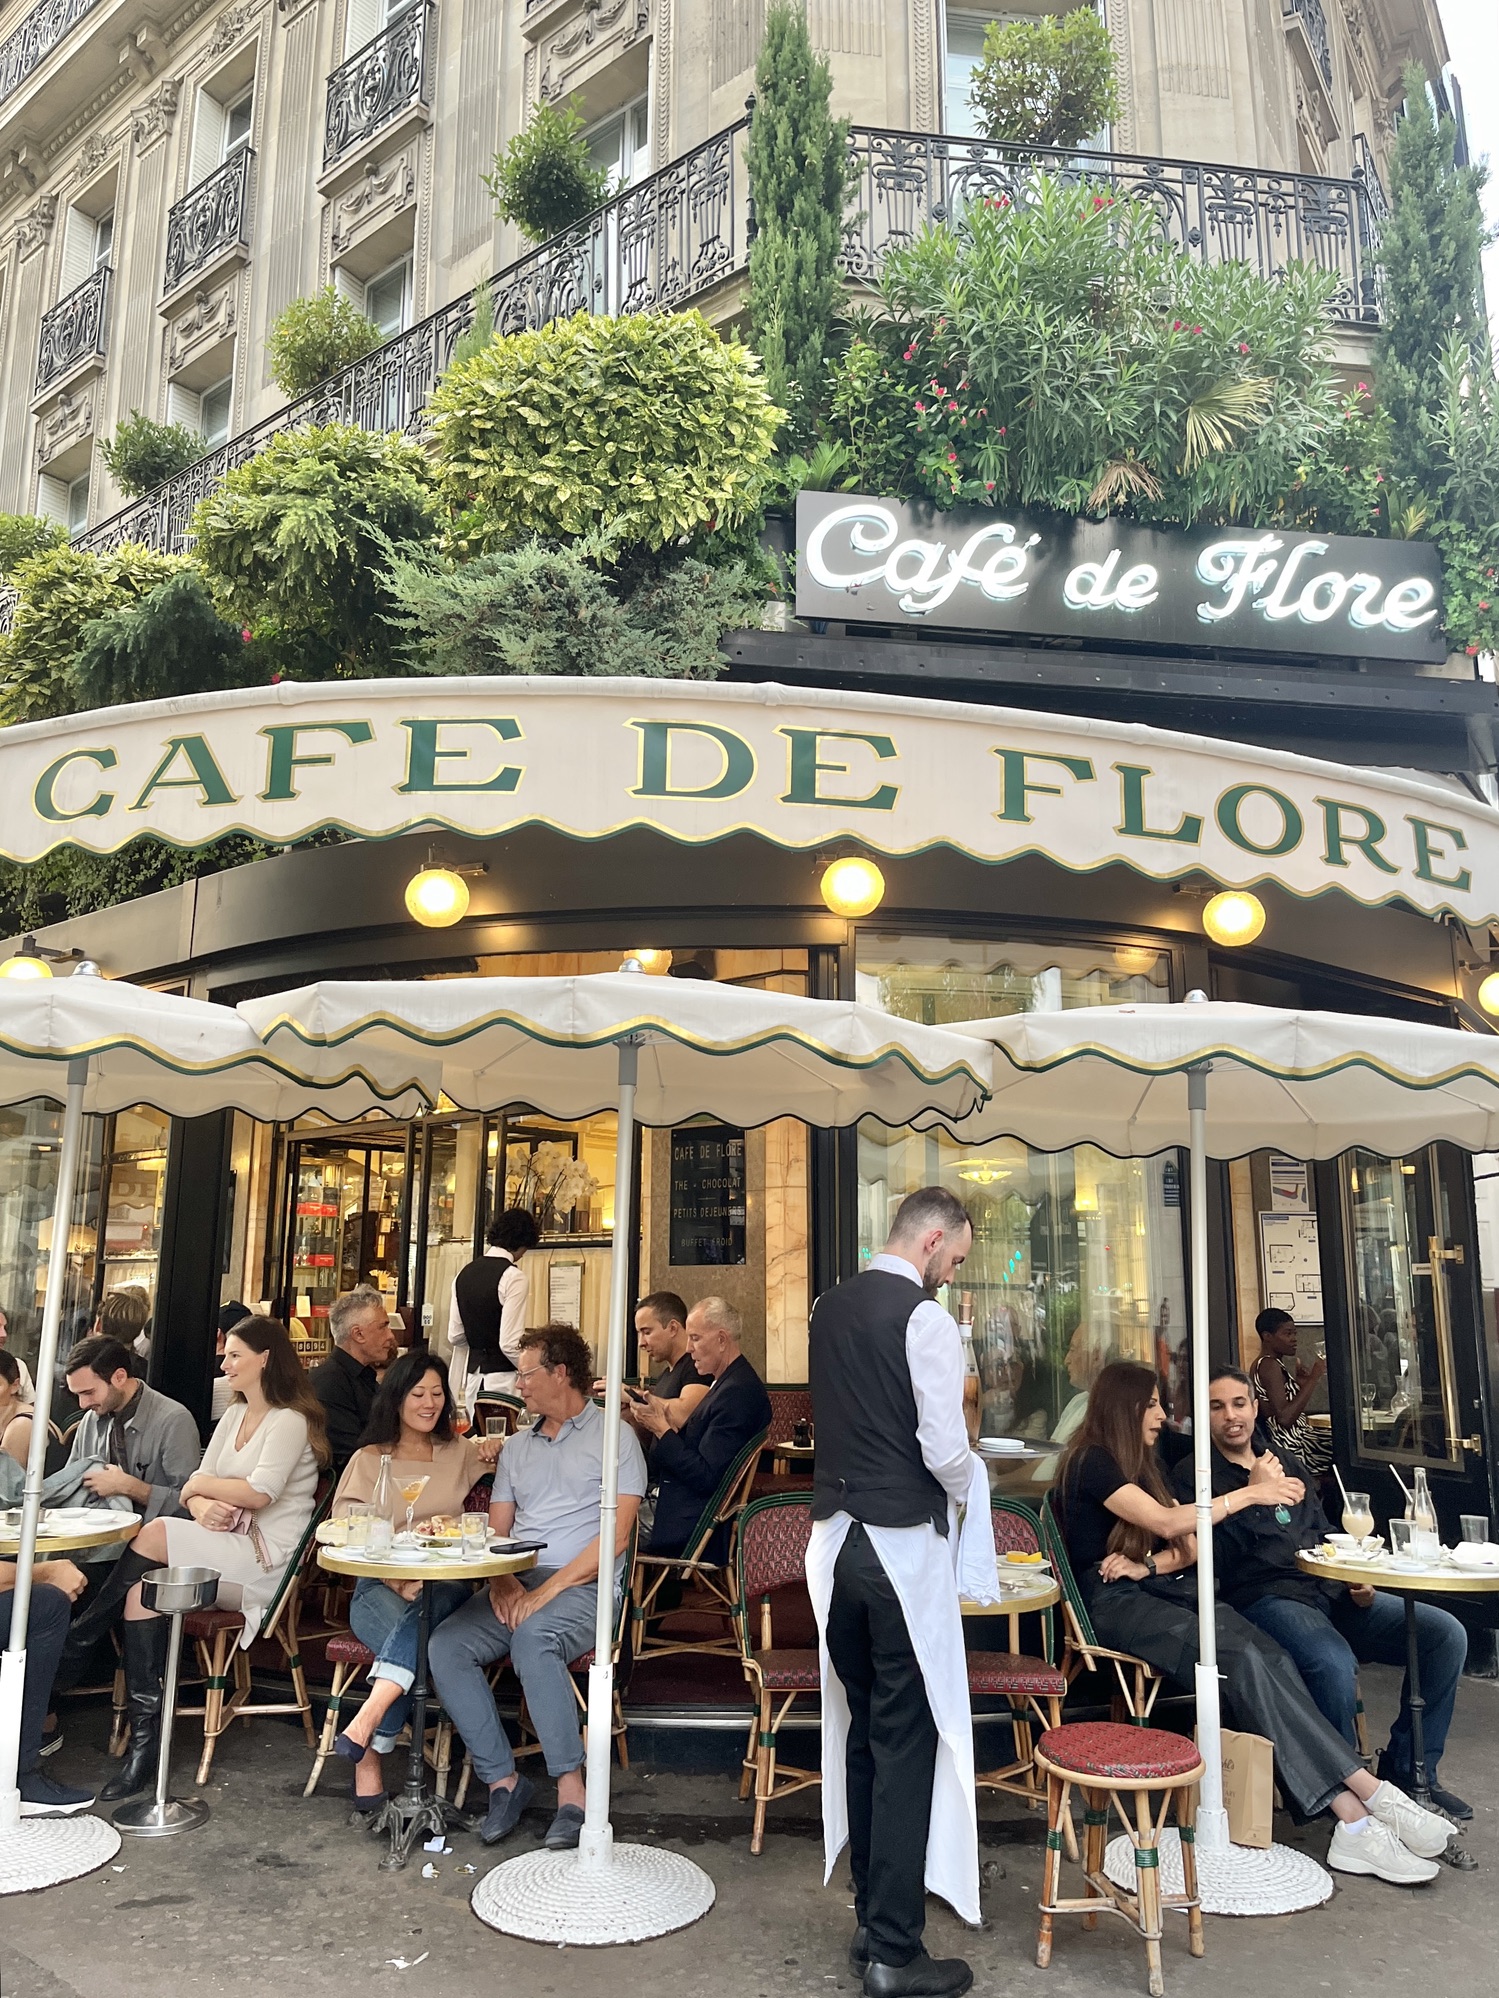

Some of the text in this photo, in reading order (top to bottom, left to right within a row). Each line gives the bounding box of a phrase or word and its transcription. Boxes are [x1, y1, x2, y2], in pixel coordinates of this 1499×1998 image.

[804, 503, 1440, 633] Café de Flore
[32, 715, 1472, 893] CAFE DE FLORE
[674, 1143, 742, 1161] CAFE DE FLORE
[674, 1180, 688, 1191] THE
[701, 1177, 741, 1189] CHOCOLAT
[673, 1207, 697, 1219] PETITS
[681, 1238, 707, 1247] BUFFET
